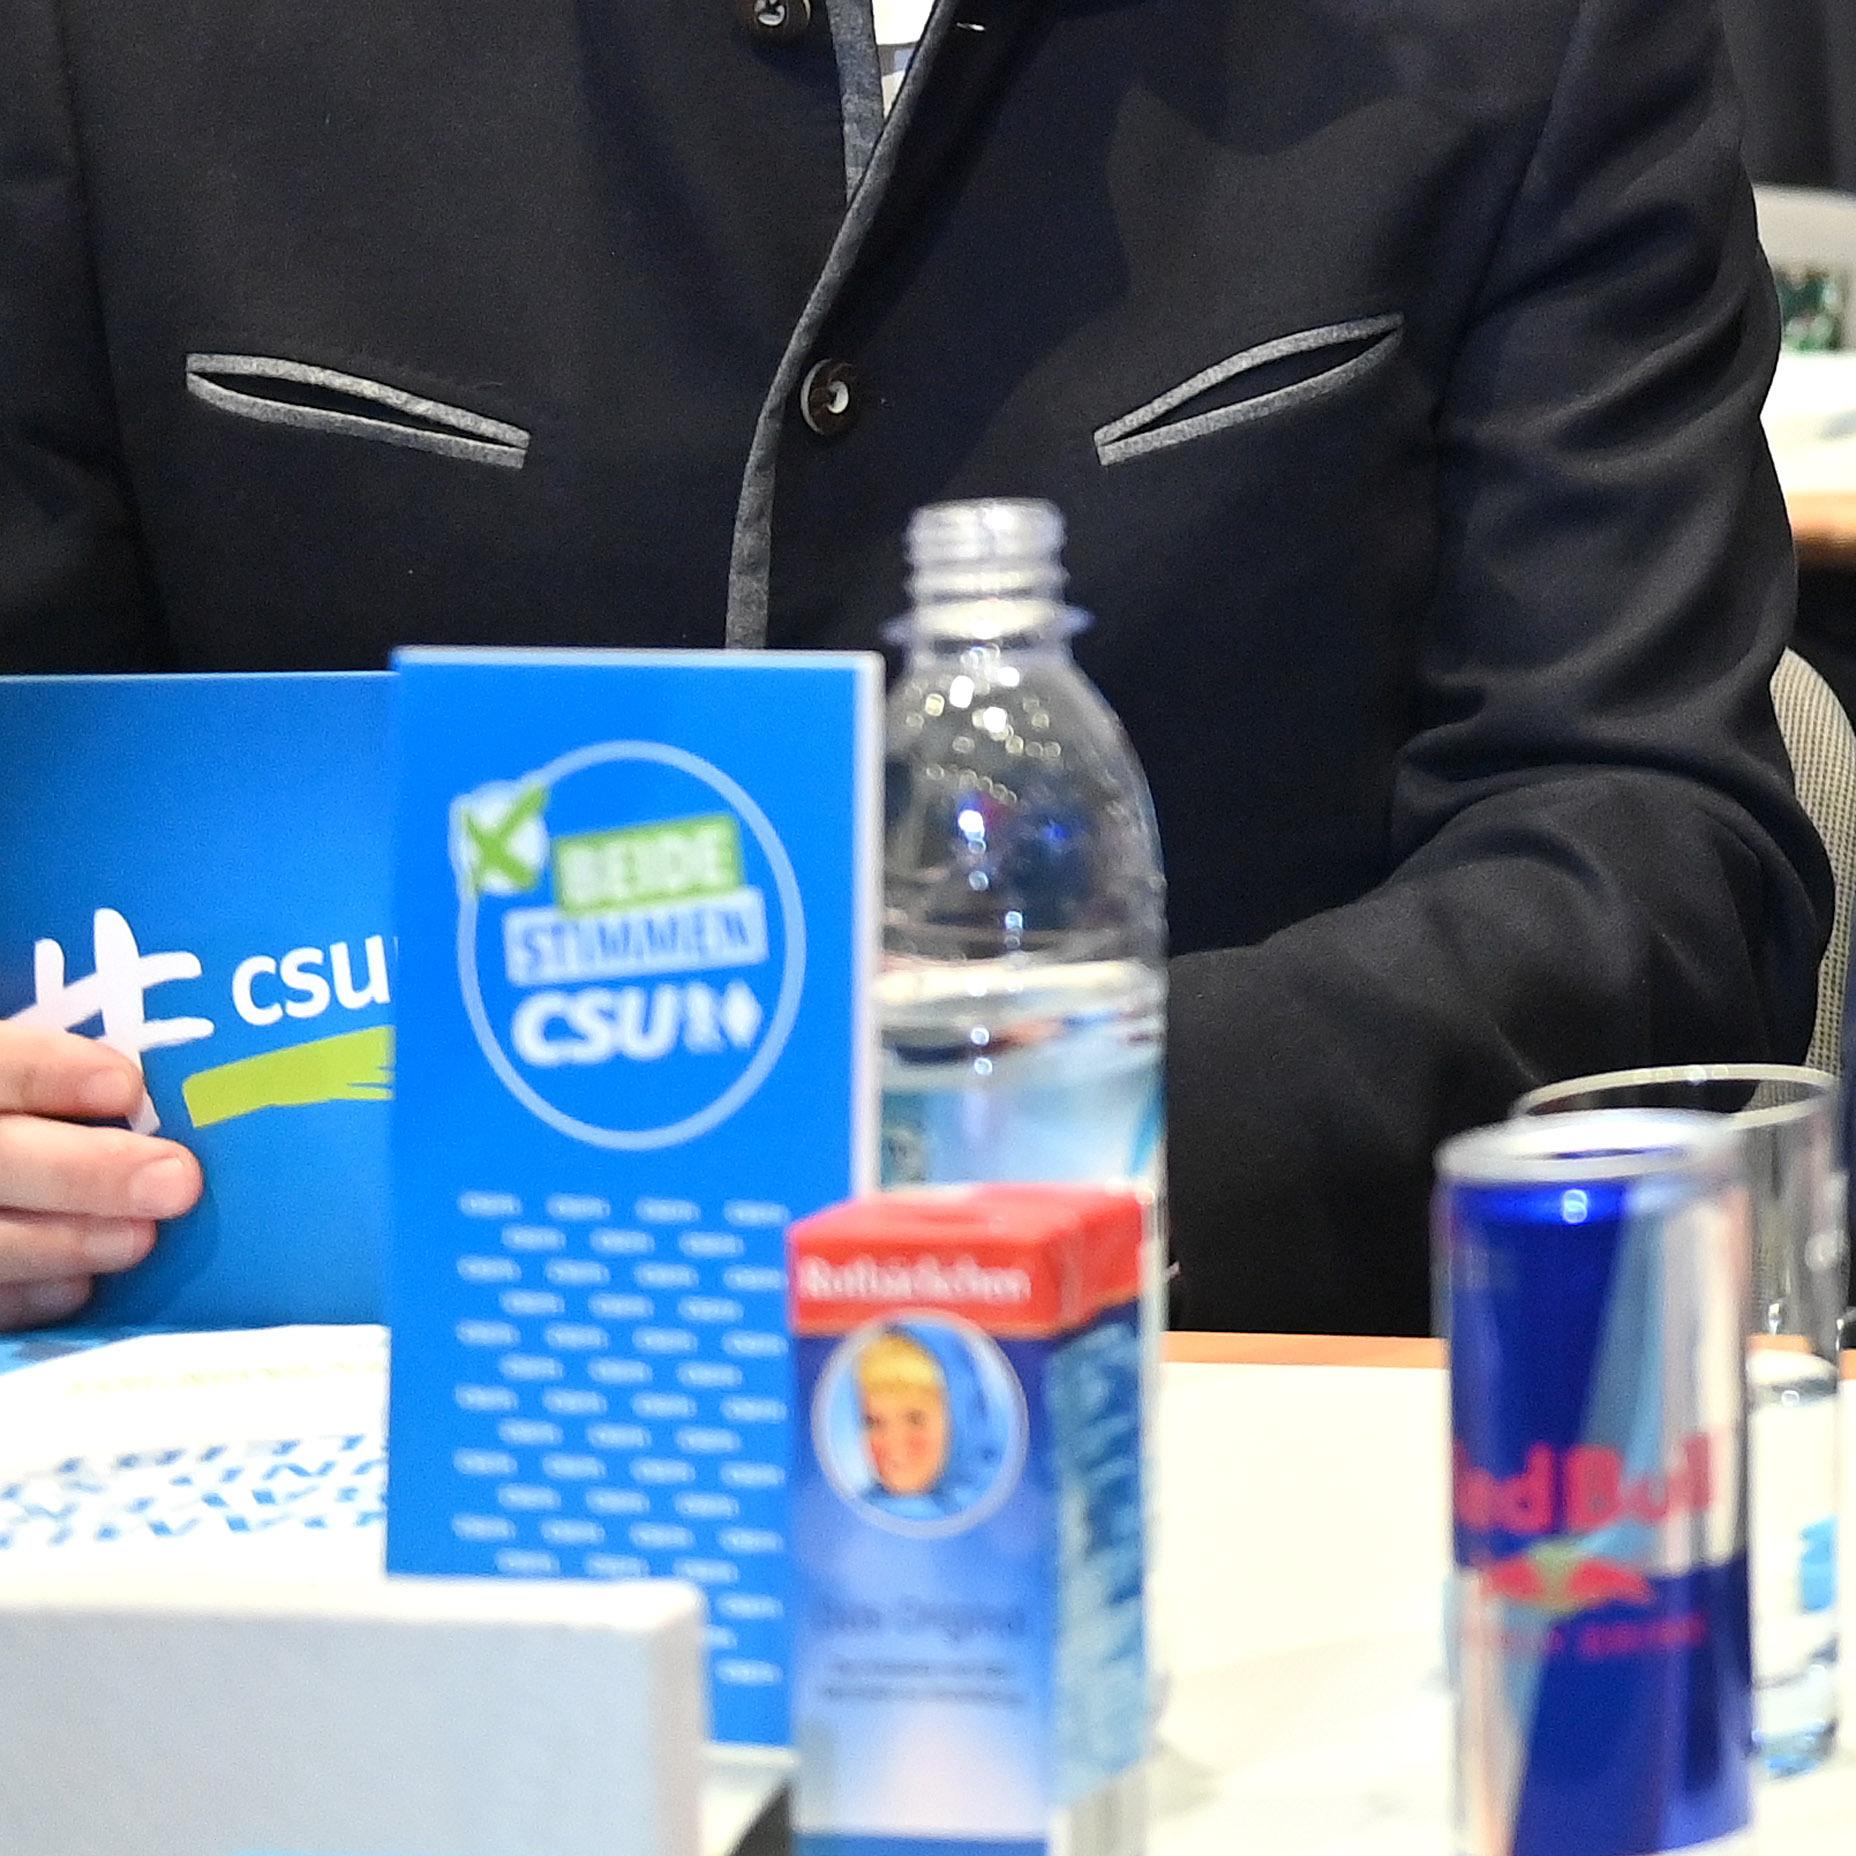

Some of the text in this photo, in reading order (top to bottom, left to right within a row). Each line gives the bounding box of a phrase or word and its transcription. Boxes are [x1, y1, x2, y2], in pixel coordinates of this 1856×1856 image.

[560, 826, 737, 906] BEIDE
[515, 904, 755, 974] STIMMEN
[512, 982, 682, 1068] CSU
